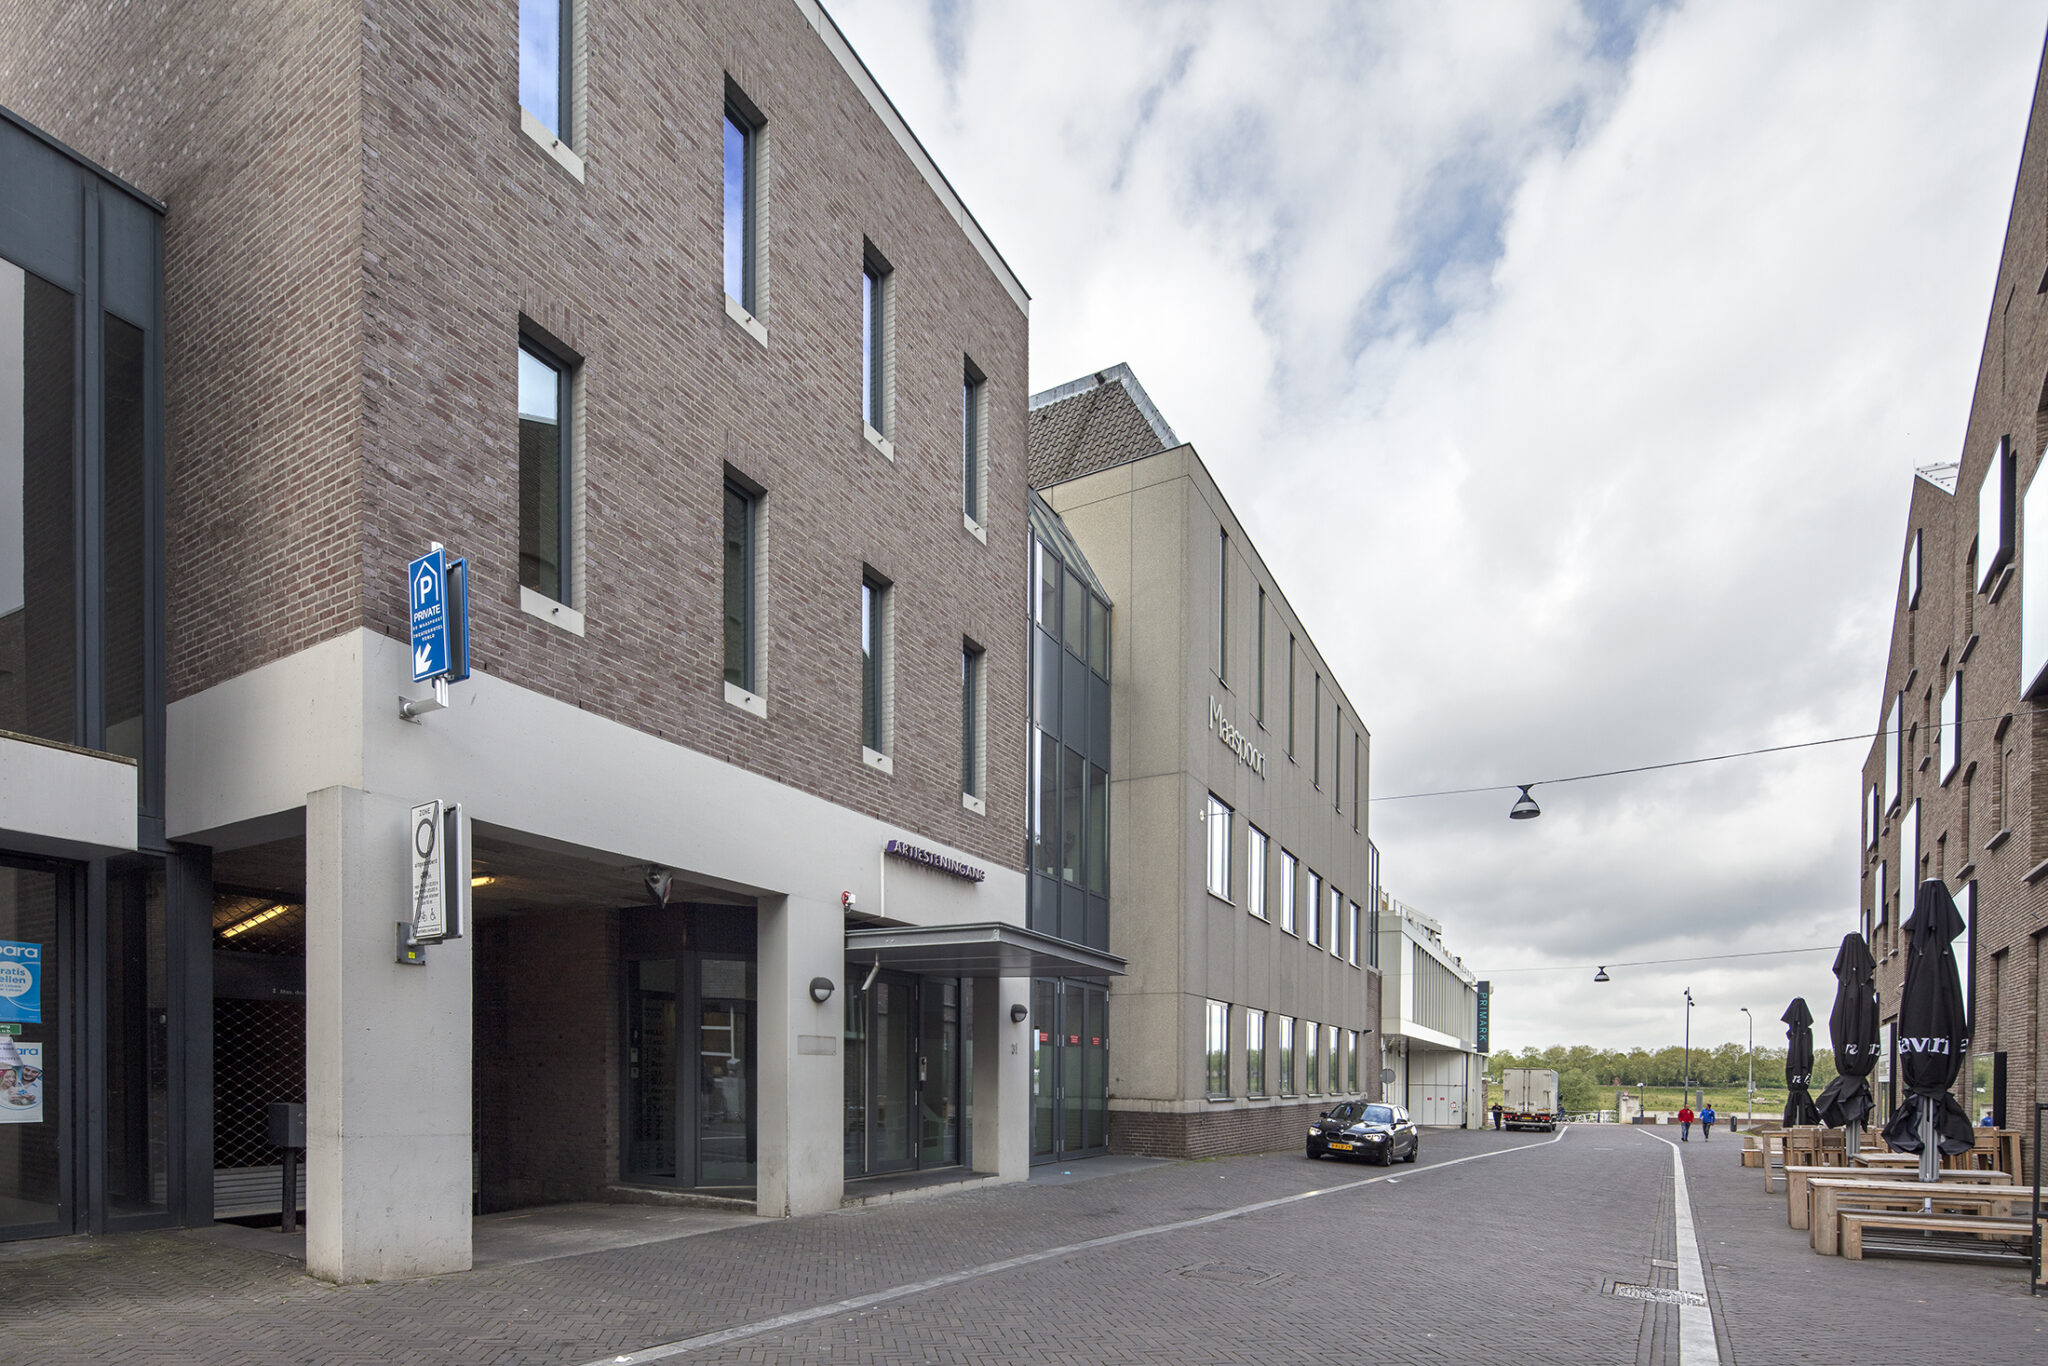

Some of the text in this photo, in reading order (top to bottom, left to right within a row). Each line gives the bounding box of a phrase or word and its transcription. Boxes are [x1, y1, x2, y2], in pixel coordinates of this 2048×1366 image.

[420, 575, 432, 604] P
[414, 603, 441, 622] PRIVATE
[1208, 695, 1266, 781] Maaspoort
[894, 841, 986, 881] ARTIESTENINGANG
[1479, 992, 1488, 1042] PRIMARK
